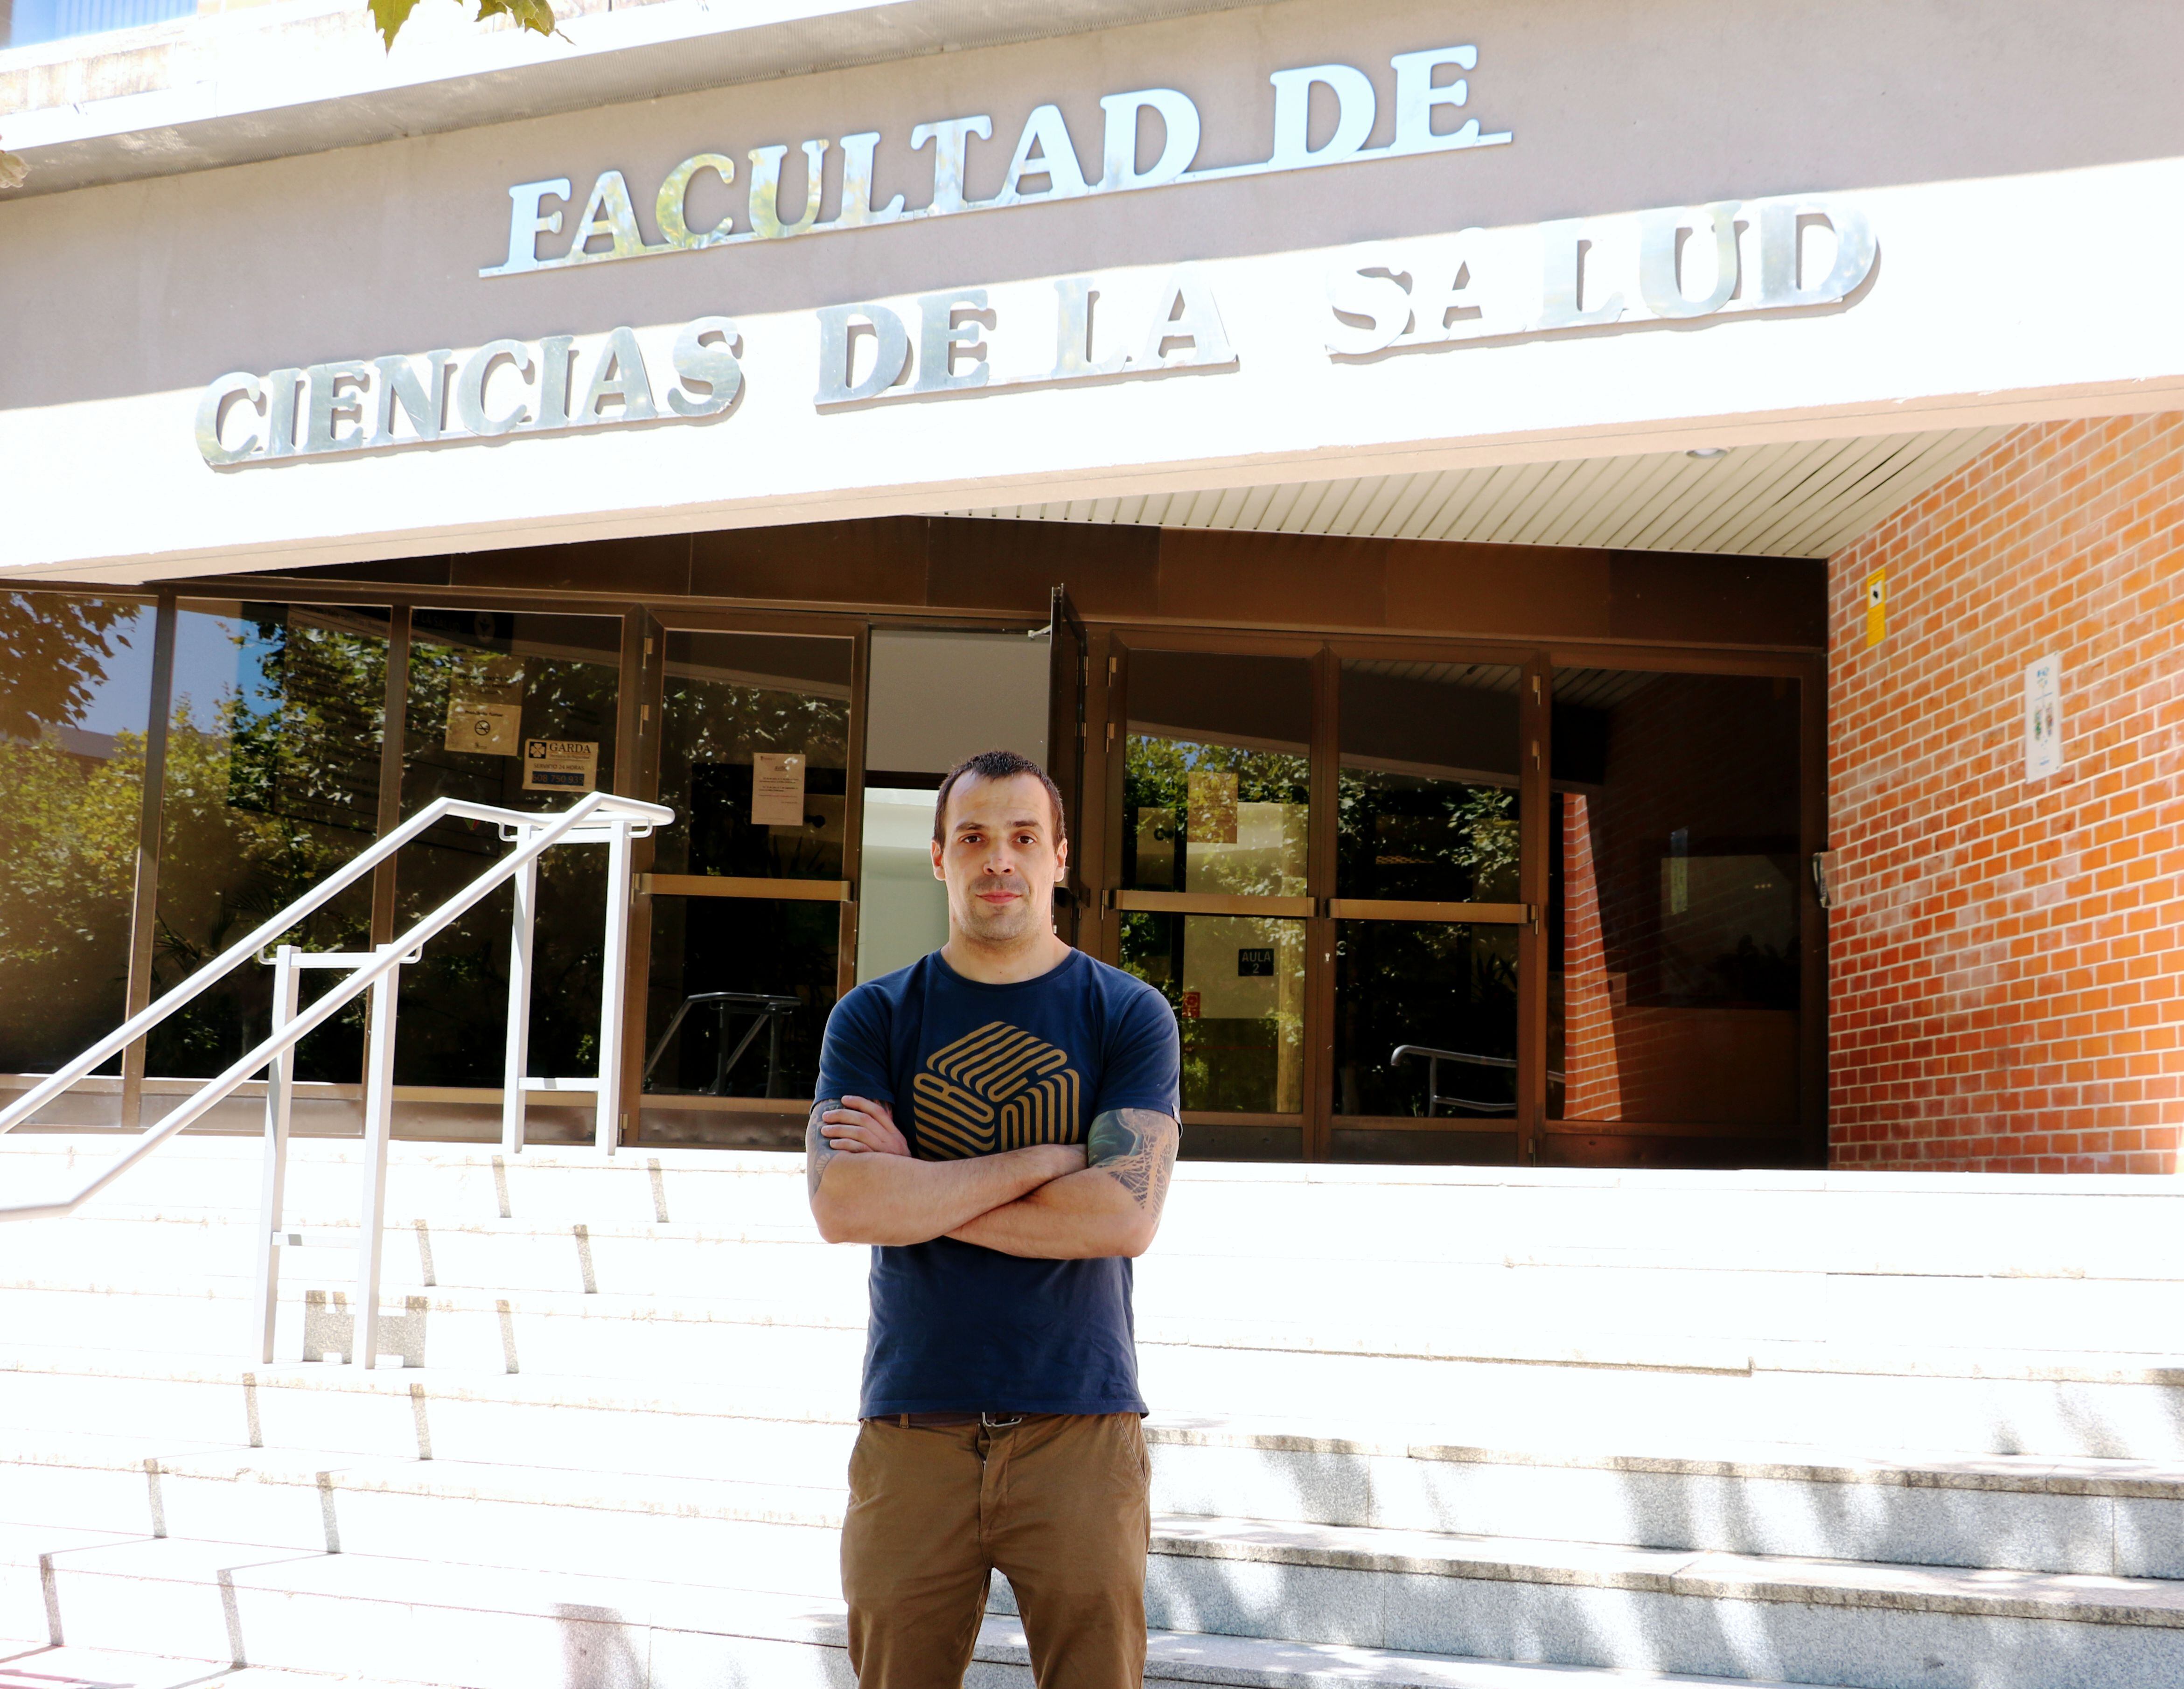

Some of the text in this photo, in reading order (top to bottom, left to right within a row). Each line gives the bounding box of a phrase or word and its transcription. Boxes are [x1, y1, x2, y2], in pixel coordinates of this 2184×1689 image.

[504, 44, 1479, 270] FACULTAD DE
[195, 192, 1878, 466] CIENCIAS DE LA SALUD
[549, 742, 591, 754] GARDA
[551, 775, 566, 783] 750
[568, 775, 584, 784] 935
[1242, 951, 1271, 962] AULA
[1253, 963, 1259, 974] 2
